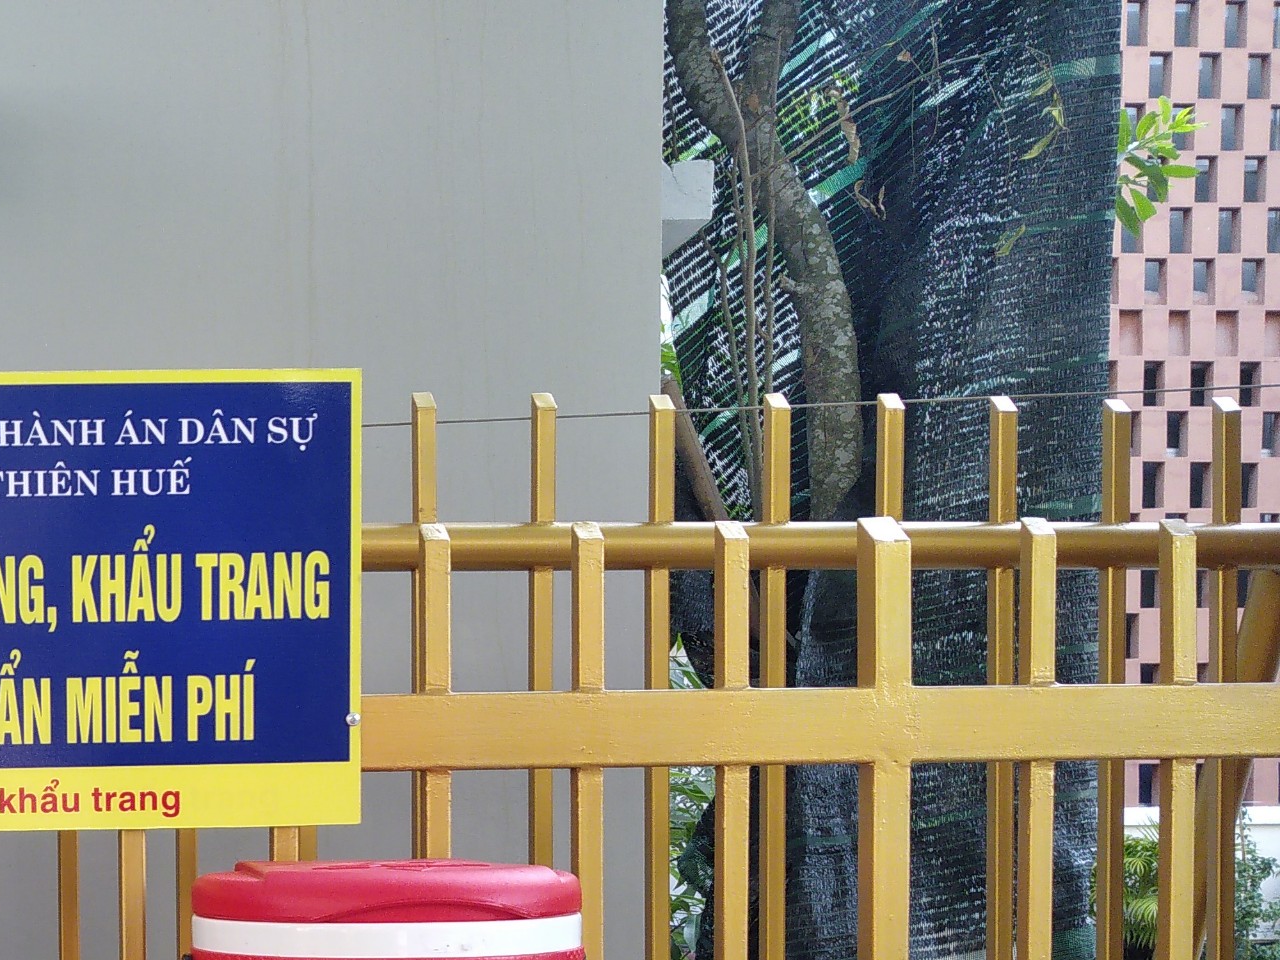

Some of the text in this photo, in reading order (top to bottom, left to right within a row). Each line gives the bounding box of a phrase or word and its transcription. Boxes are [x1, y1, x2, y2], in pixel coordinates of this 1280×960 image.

[114, 410, 169, 446] ÁN
[178, 409, 258, 445] DÂN
[267, 413, 318, 451] SỰ
[111, 456, 193, 495] HUẾ
[71, 524, 182, 624] KHẨU
[195, 550, 331, 621] TRANG
[66, 650, 173, 744] MIỄN
[186, 658, 257, 742] PHÍ
[90, 787, 181, 816] trang
